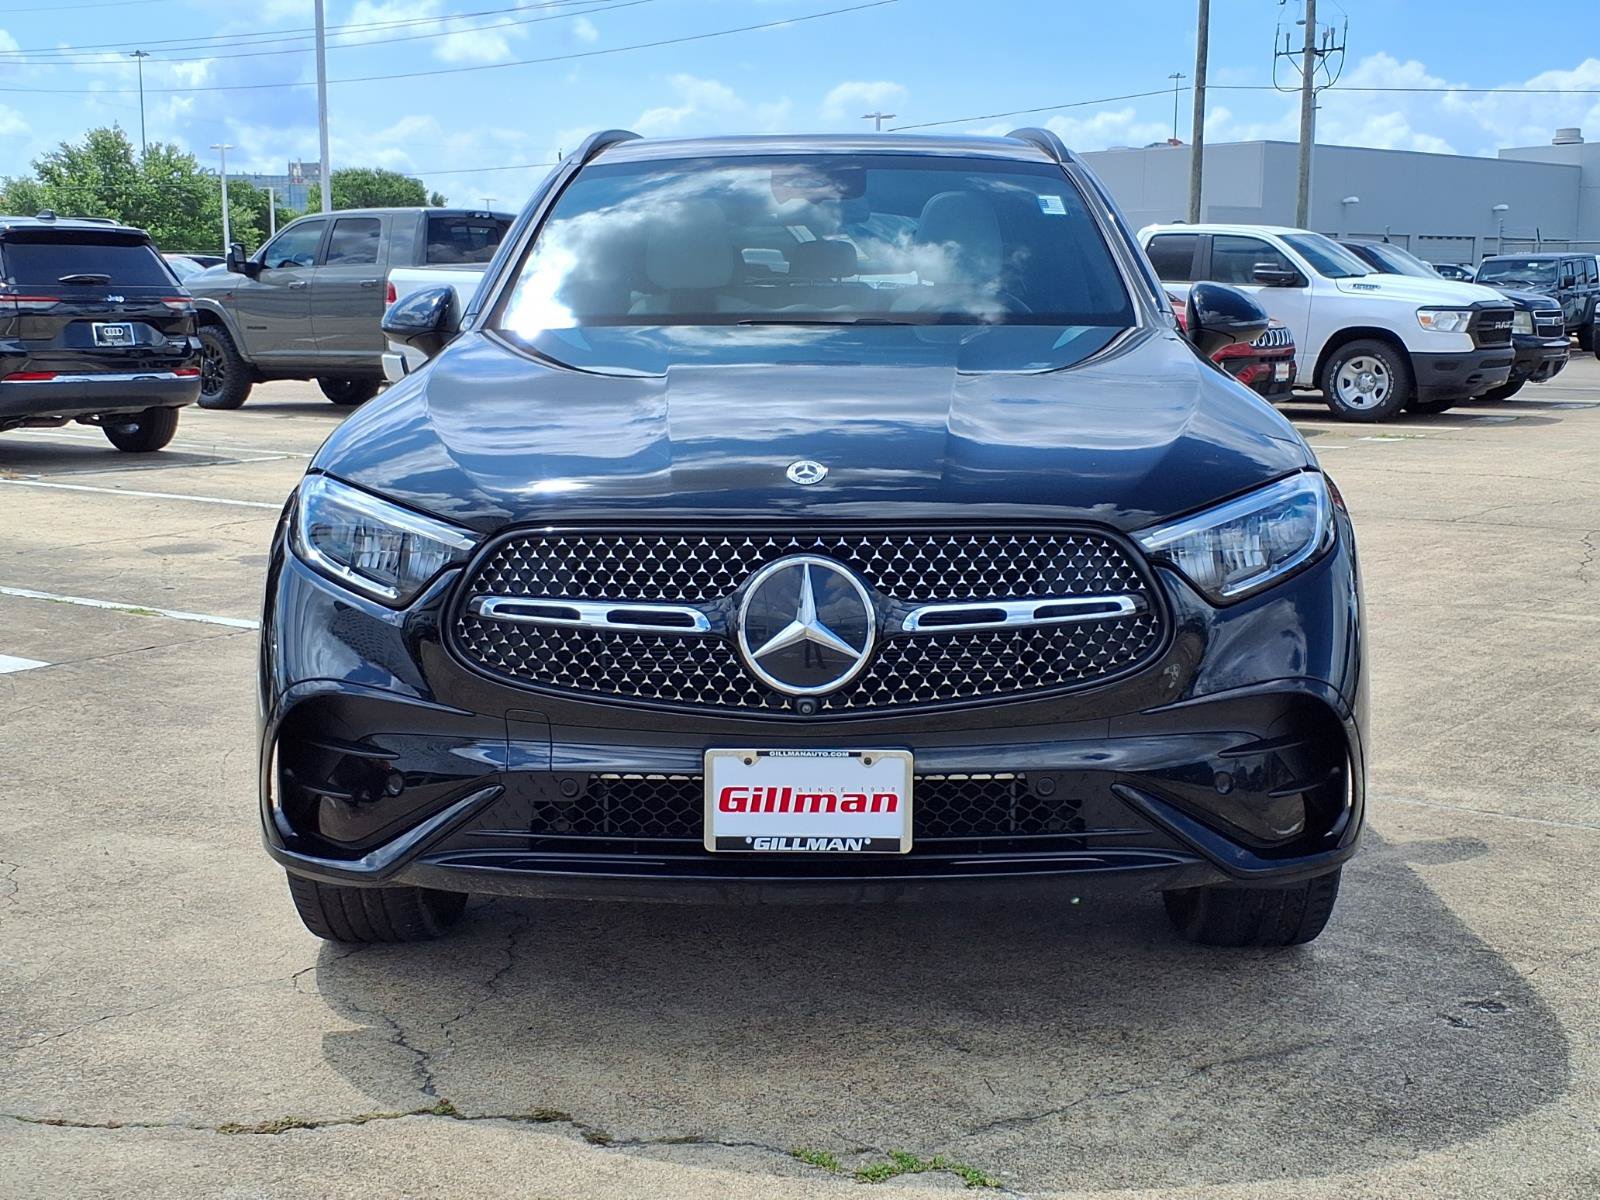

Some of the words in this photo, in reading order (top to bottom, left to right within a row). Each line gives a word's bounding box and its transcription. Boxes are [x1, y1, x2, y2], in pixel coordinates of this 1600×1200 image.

[107, 294, 125, 303] Jeep
[769, 750, 849, 758] GILLMANAUTO.COM
[718, 787, 898, 813] Gillman
[753, 837, 863, 851] GILLMAN
